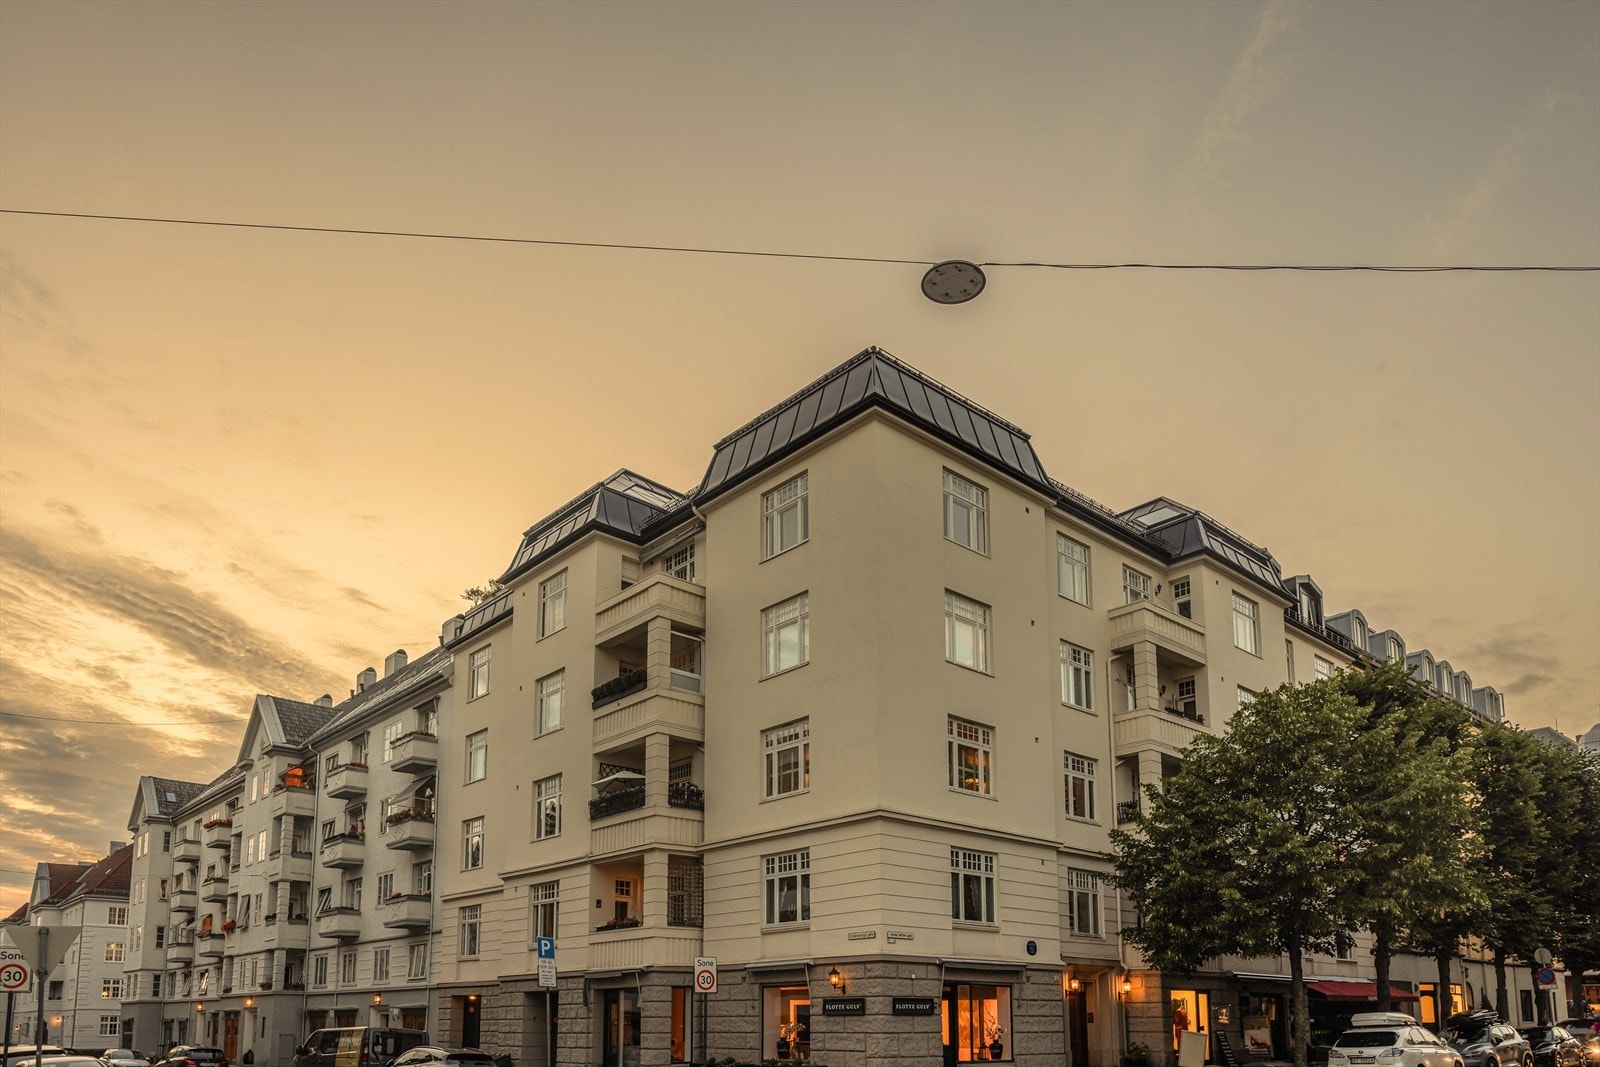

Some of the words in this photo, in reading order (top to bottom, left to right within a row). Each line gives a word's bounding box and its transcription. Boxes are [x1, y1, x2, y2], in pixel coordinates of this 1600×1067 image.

[542, 940, 550, 956] P
[4, 970, 22, 982] 30
[701, 976, 712, 984] 30
